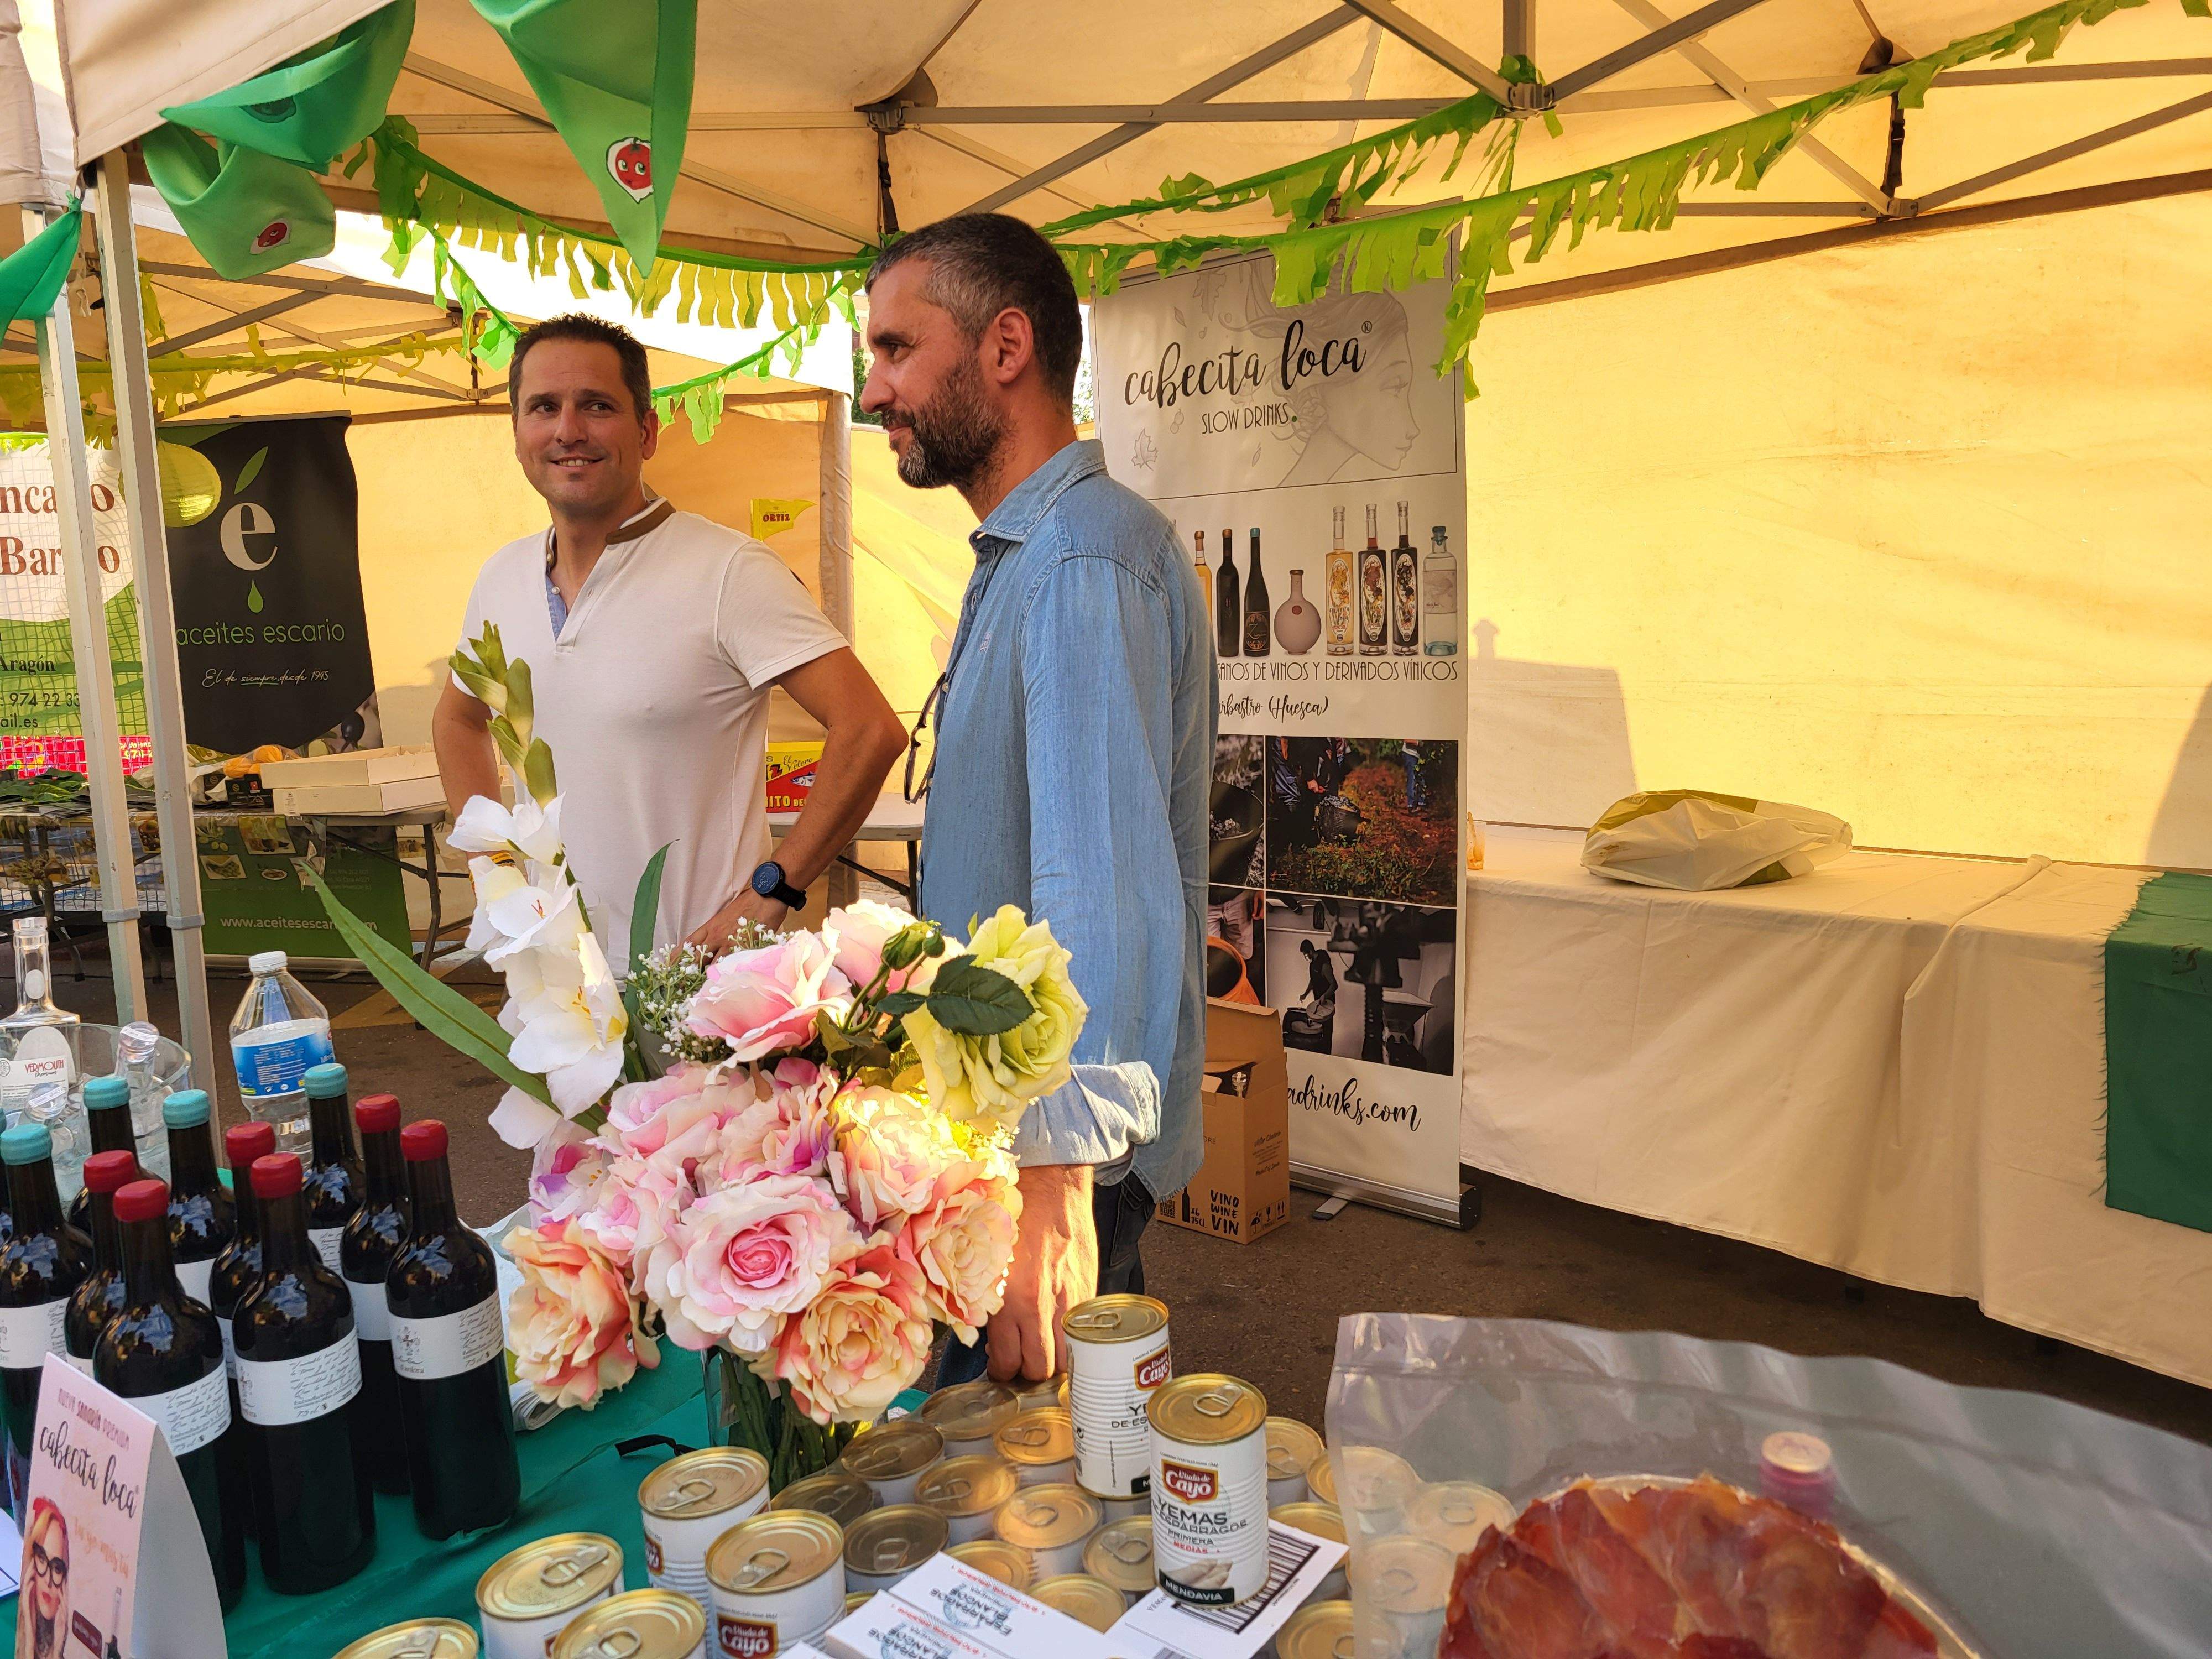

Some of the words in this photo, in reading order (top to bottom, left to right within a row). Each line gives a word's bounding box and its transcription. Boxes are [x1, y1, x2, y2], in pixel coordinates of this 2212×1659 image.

[1124, 342, 1266, 408] cabecita
[1202, 409, 1239, 435] SLOW
[763, 513, 790, 523] ORTIZ
[176, 621, 255, 646] aceites
[263, 618, 345, 643] escario
[202, 669, 223, 687] El
[225, 670, 238, 686] de
[241, 674, 278, 687] siempre
[279, 669, 307, 686] desde
[311, 671, 329, 681] 1945
[1253, 663, 1266, 680] DE
[1270, 662, 1308, 681] VINOS
[1313, 662, 1321, 681] Y
[1326, 661, 1399, 681] DERIVADOS
[1403, 659, 1458, 681] VÍNICOS
[9, 692, 38, 707] 974
[44, 692, 60, 707] 22
[1269, 694, 1329, 724] (Huesca)
[25, 1059, 65, 1074] VERMOUTH
[1211, 1189, 1239, 1208] VINO
[1211, 1203, 1239, 1219] WINE
[1211, 1214, 1239, 1235] VIN
[1112, 1420, 1129, 1428] DE
[40, 1420, 100, 1490] cabecita
[1165, 1470, 1212, 1499] Cayo
[1178, 1470, 1200, 1481] Viuda
[1201, 1473, 1212, 1482] de
[1157, 1495, 1228, 1526] YEMAS
[1167, 1528, 1214, 1545] PRIMERA
[1173, 1540, 1208, 1554] MEDIAS
[1165, 1579, 1224, 1601] MENDAVIA
[733, 1624, 757, 1637] Viuda
[757, 1627, 769, 1637] de
[721, 1625, 770, 1658] Cayo
